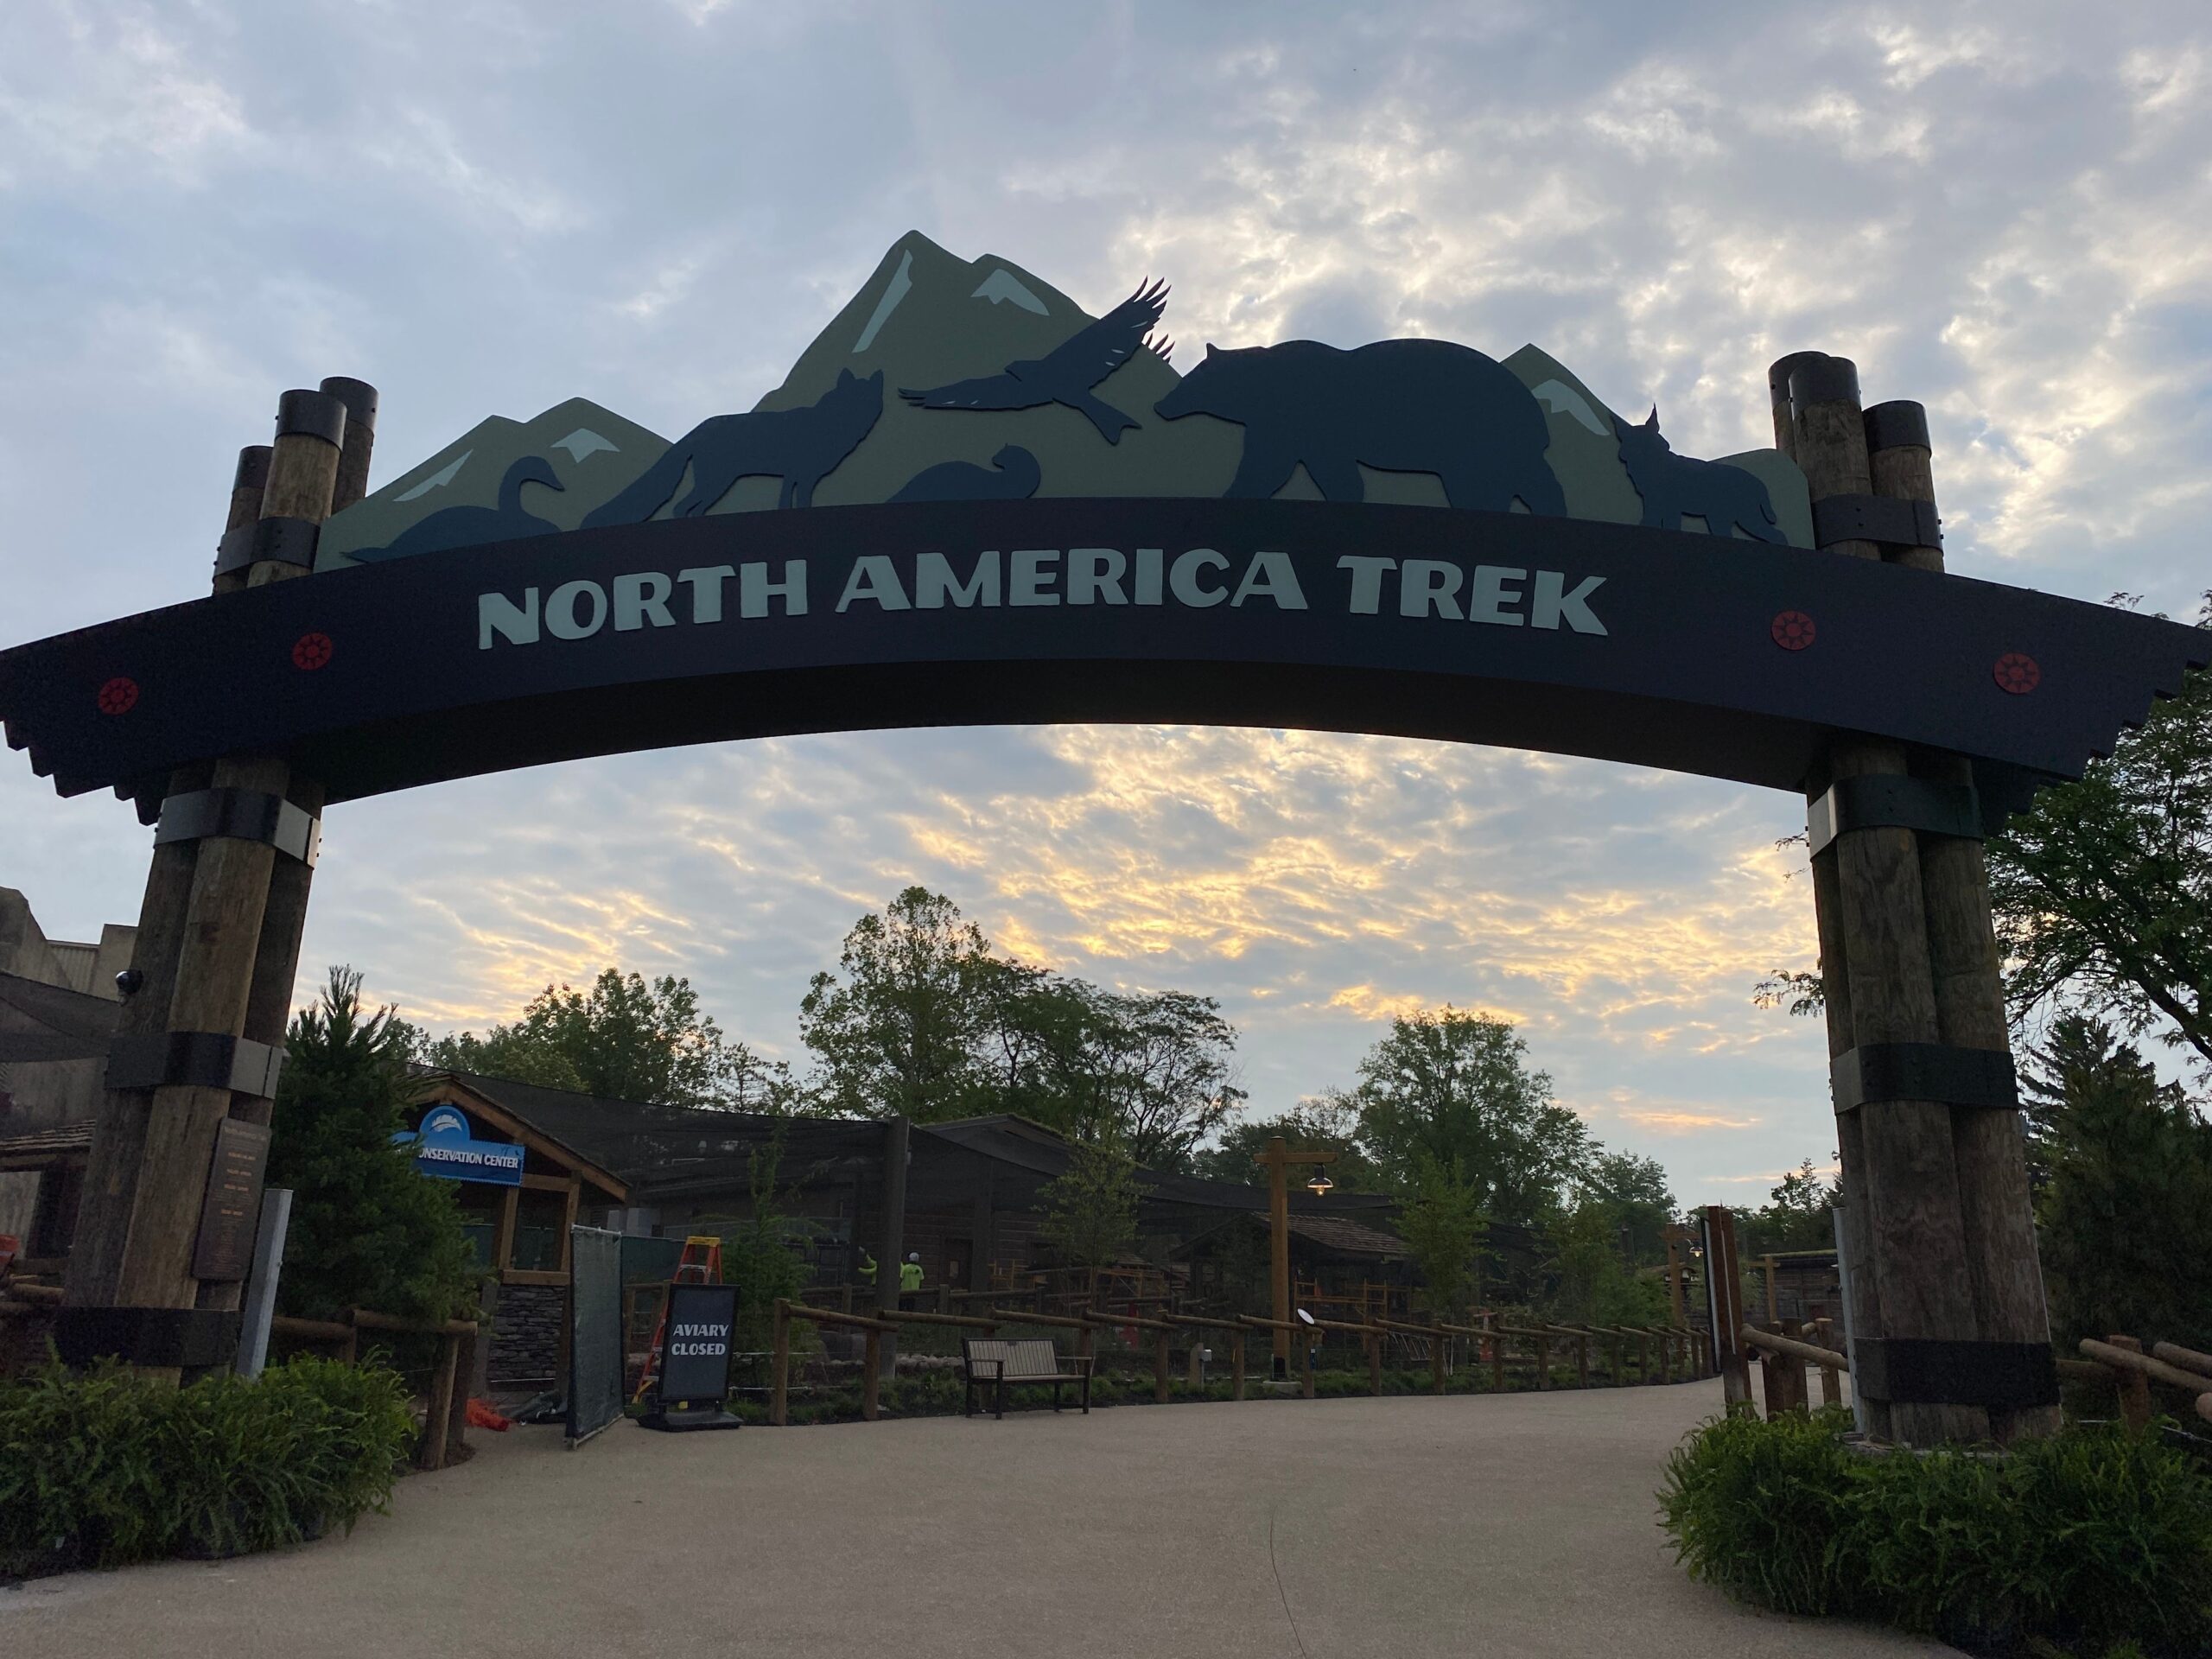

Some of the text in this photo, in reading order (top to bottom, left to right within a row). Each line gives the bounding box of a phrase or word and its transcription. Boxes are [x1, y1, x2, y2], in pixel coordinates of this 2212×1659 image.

[477, 547, 1609, 650] NORTH AMERICA TREK
[417, 1147, 518, 1168] ONSERVATION CENTER
[673, 1325, 729, 1337] AVIARY
[671, 1344, 726, 1355] CLOSED
